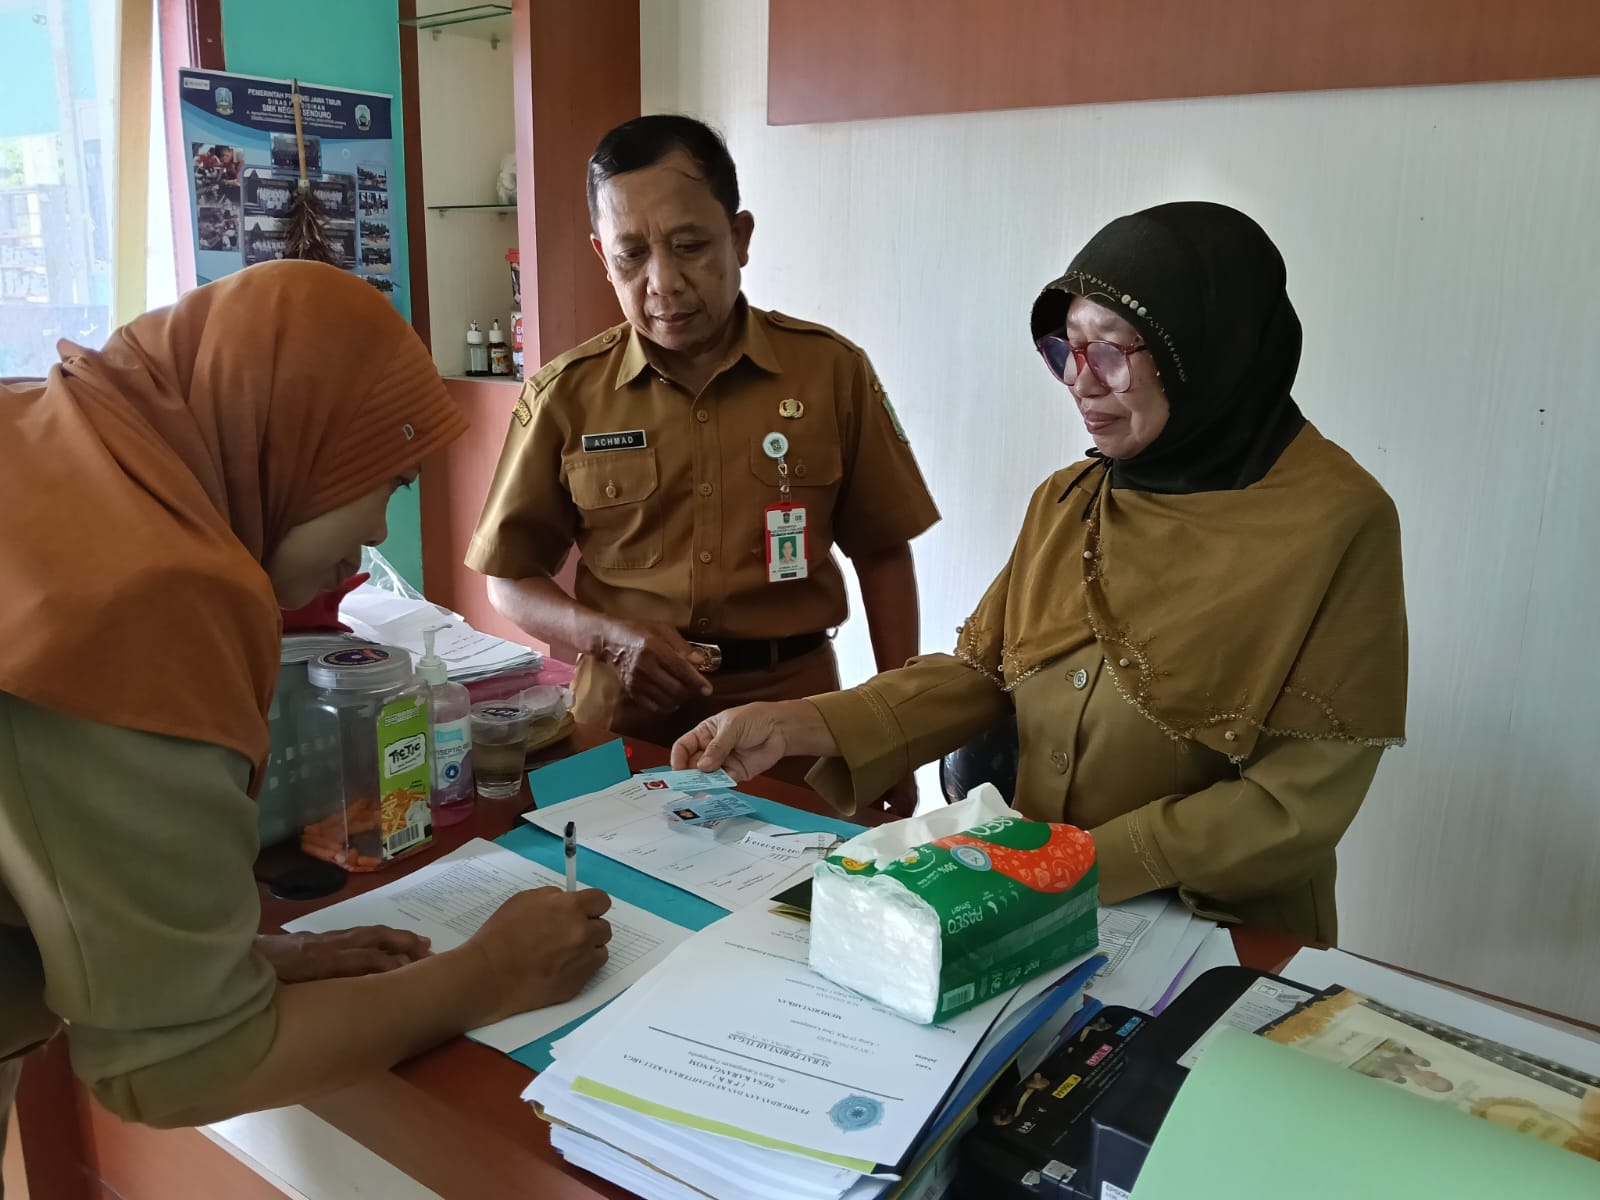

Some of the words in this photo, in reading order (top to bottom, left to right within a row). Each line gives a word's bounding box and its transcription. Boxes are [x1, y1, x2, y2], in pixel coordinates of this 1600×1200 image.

[248, 88, 284, 99] PEMERINTAH
[311, 96, 325, 104] JAWA
[262, 104, 277, 113] SMK
[302, 108, 332, 120] SENDURO
[594, 436, 634, 447] ACHMAD
[947, 905, 983, 934] PASEO
[755, 1042, 799, 1061] PERINTAH
[801, 1054, 830, 1068] SURAT
[688, 1058, 751, 1081] KARANGANOM
[752, 1075, 775, 1089] DESA
